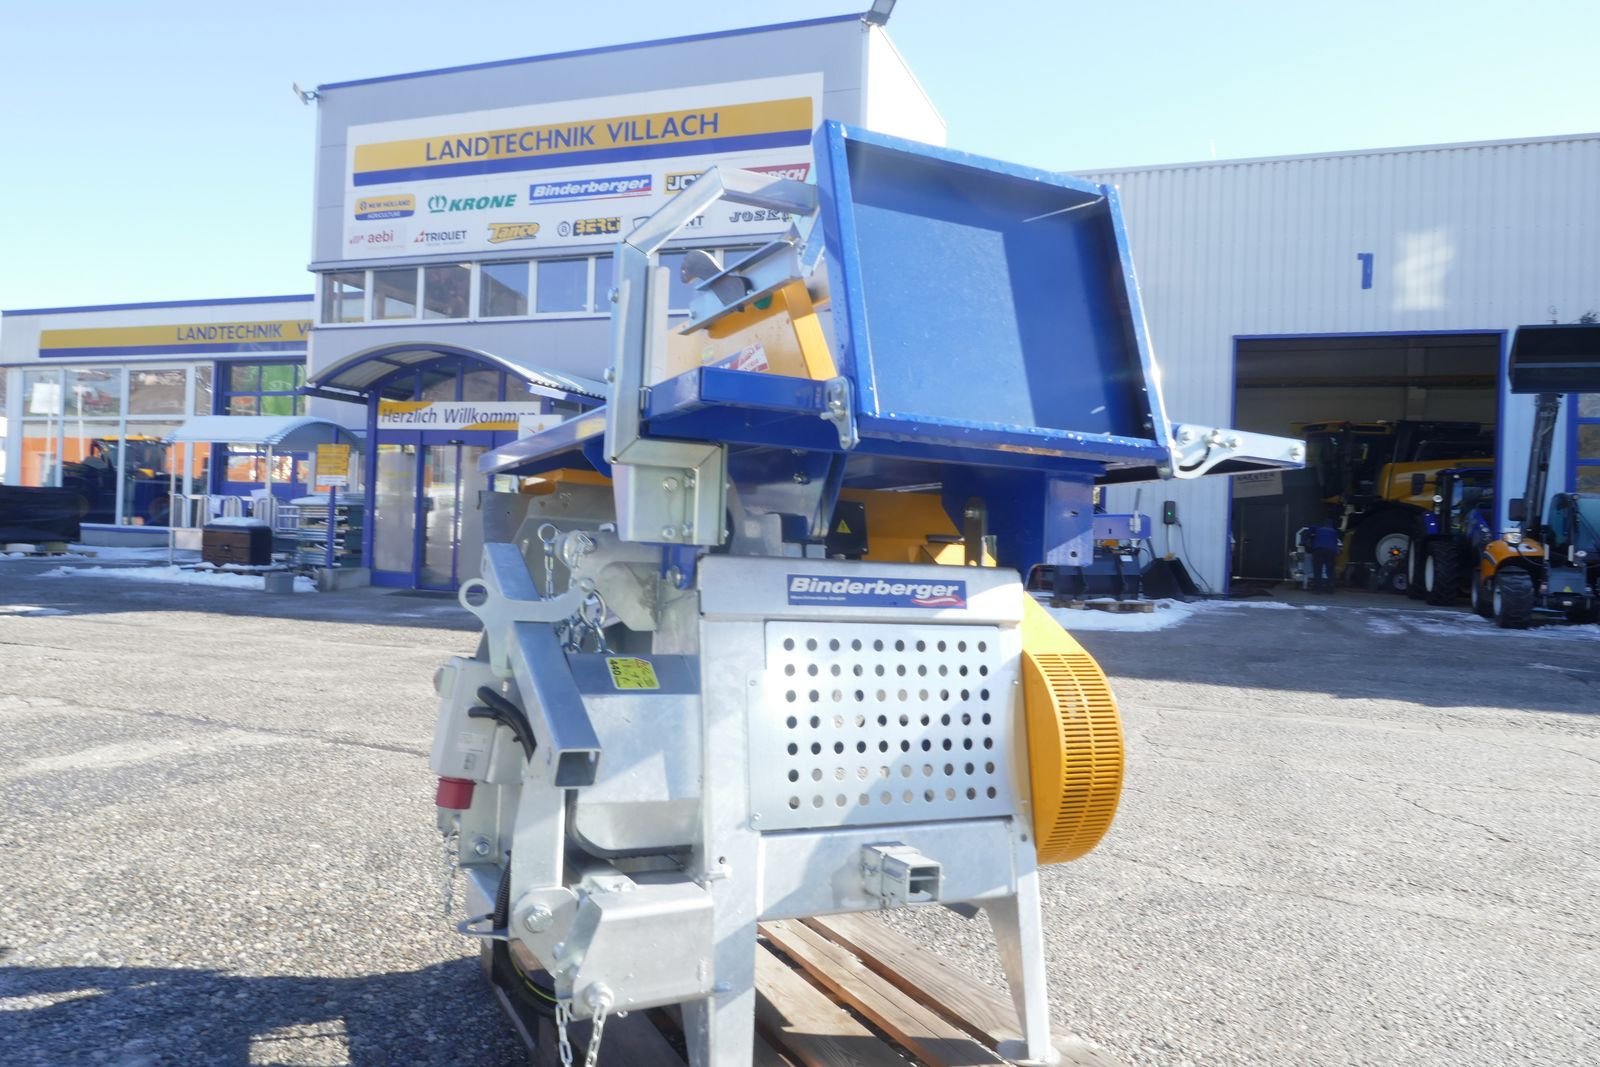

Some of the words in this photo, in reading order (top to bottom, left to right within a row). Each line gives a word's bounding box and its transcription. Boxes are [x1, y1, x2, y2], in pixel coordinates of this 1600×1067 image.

[425, 124, 596, 161] LANDTECHNIK
[606, 112, 719, 143] VILLACH
[532, 178, 650, 198] Binderberger
[666, 174, 703, 191] JC
[448, 194, 517, 212] KRONE
[367, 229, 394, 244] aebi
[1357, 252, 1374, 290] 1
[176, 323, 283, 341] LANDTECHNIK
[381, 408, 438, 424] Herzlich
[444, 407, 537, 424] Willkomm
[789, 576, 960, 599] Binderberger
